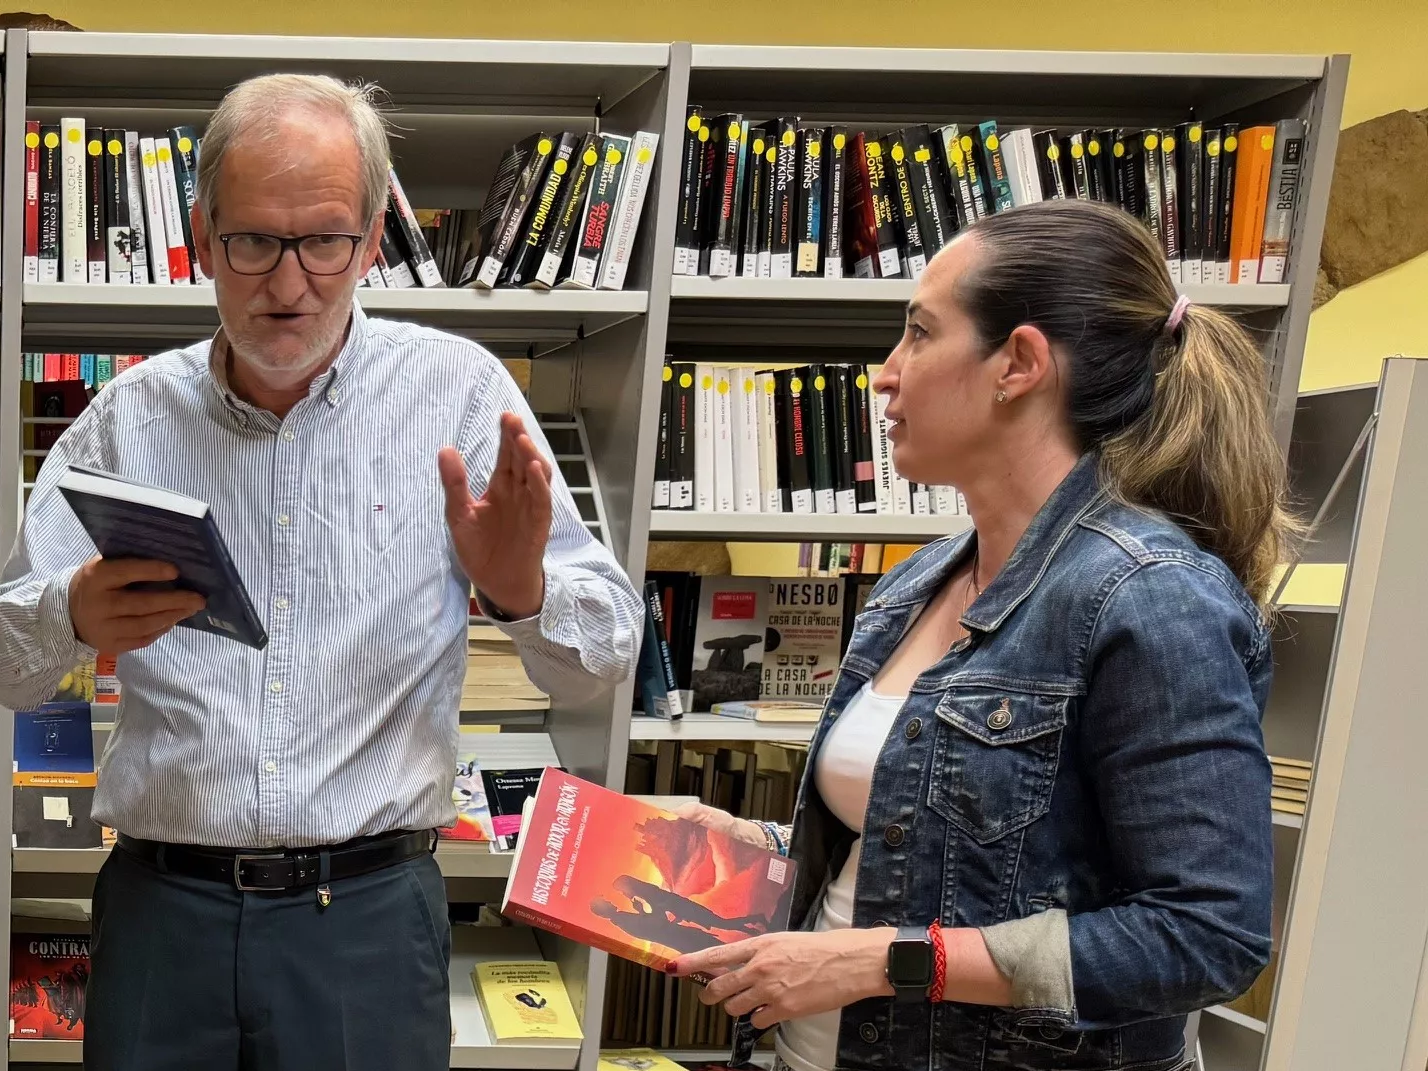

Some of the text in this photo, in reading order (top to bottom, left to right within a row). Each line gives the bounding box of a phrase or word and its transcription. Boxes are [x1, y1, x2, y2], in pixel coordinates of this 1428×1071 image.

[786, 149, 796, 182] PAULA
[527, 174, 562, 246] LA COMUNIDAD
[584, 203, 599, 248] TURBIA
[593, 201, 611, 249] SANGRE
[776, 583, 838, 608] NESBØ
[792, 616, 801, 625] DE
[803, 616, 813, 625] LA
[814, 616, 841, 626] NOCHE
